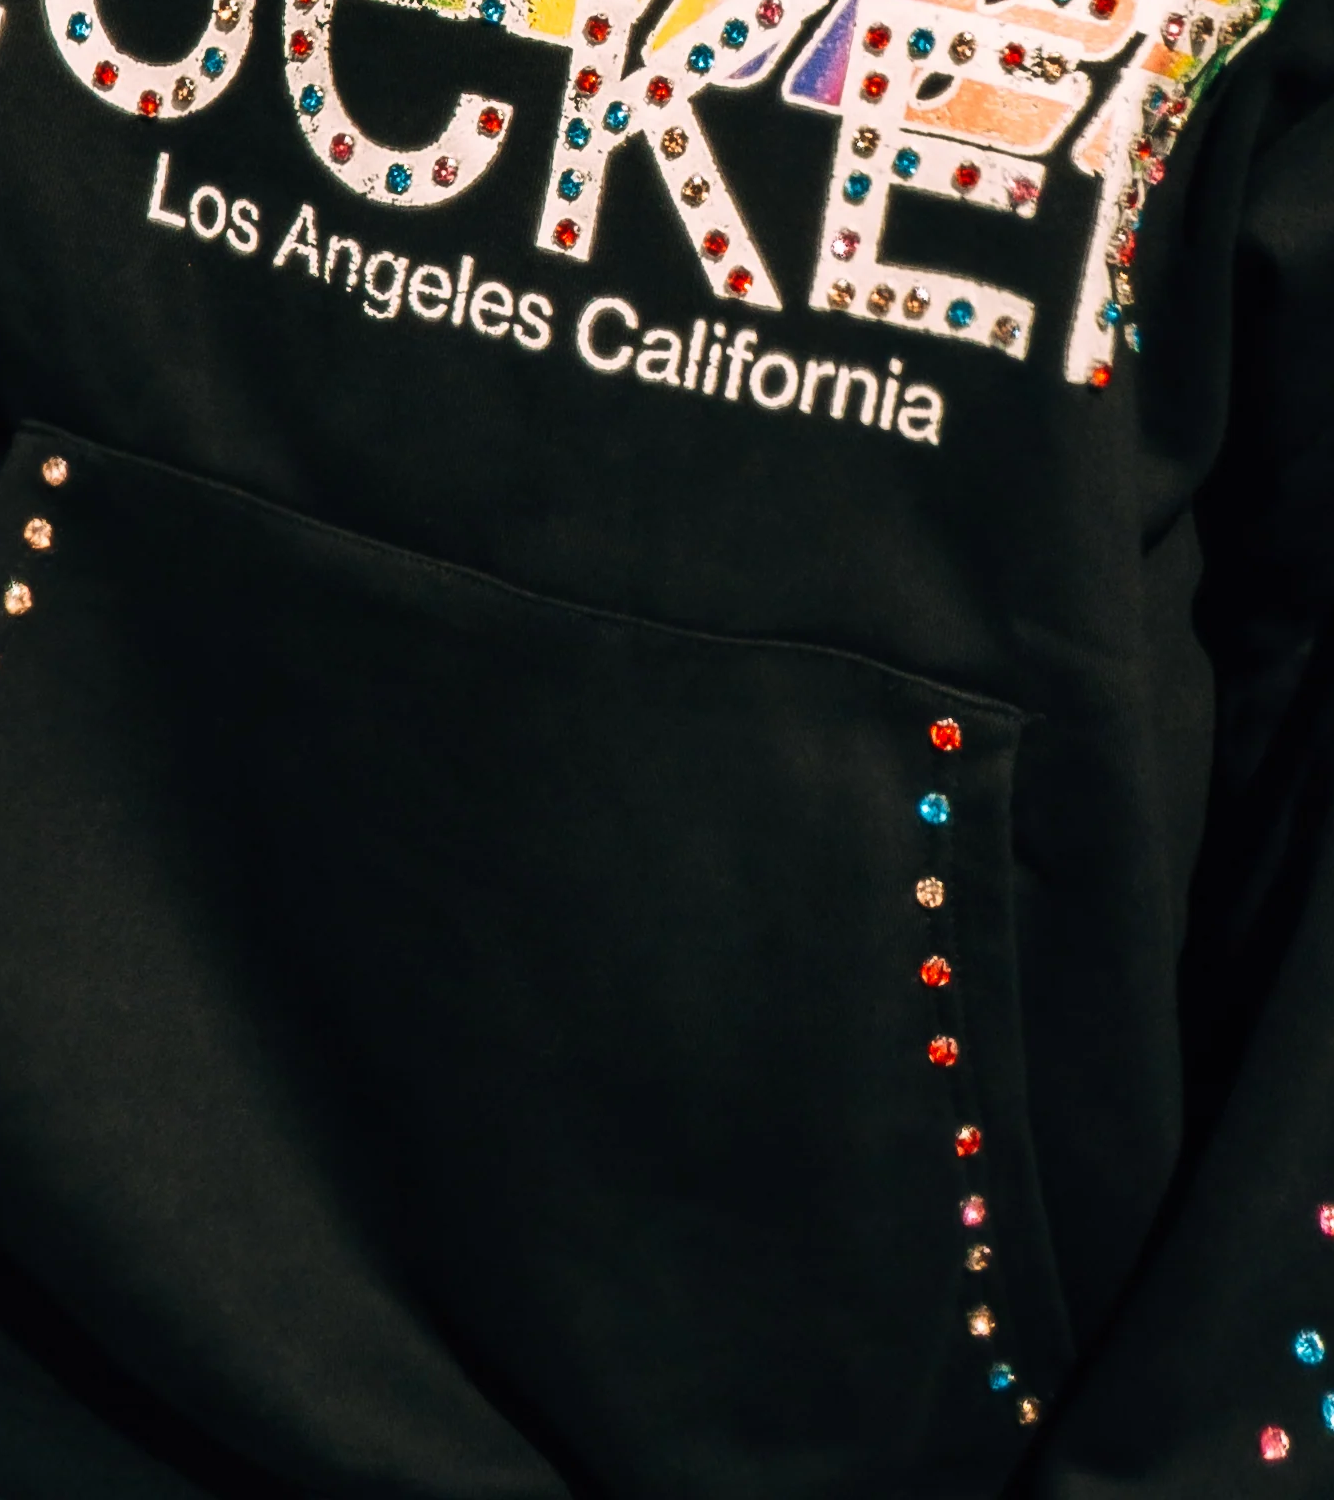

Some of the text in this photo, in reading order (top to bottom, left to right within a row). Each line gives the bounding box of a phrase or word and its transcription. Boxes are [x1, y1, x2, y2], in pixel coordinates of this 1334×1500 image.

[147, 151, 945, 447] Los Angeles California
